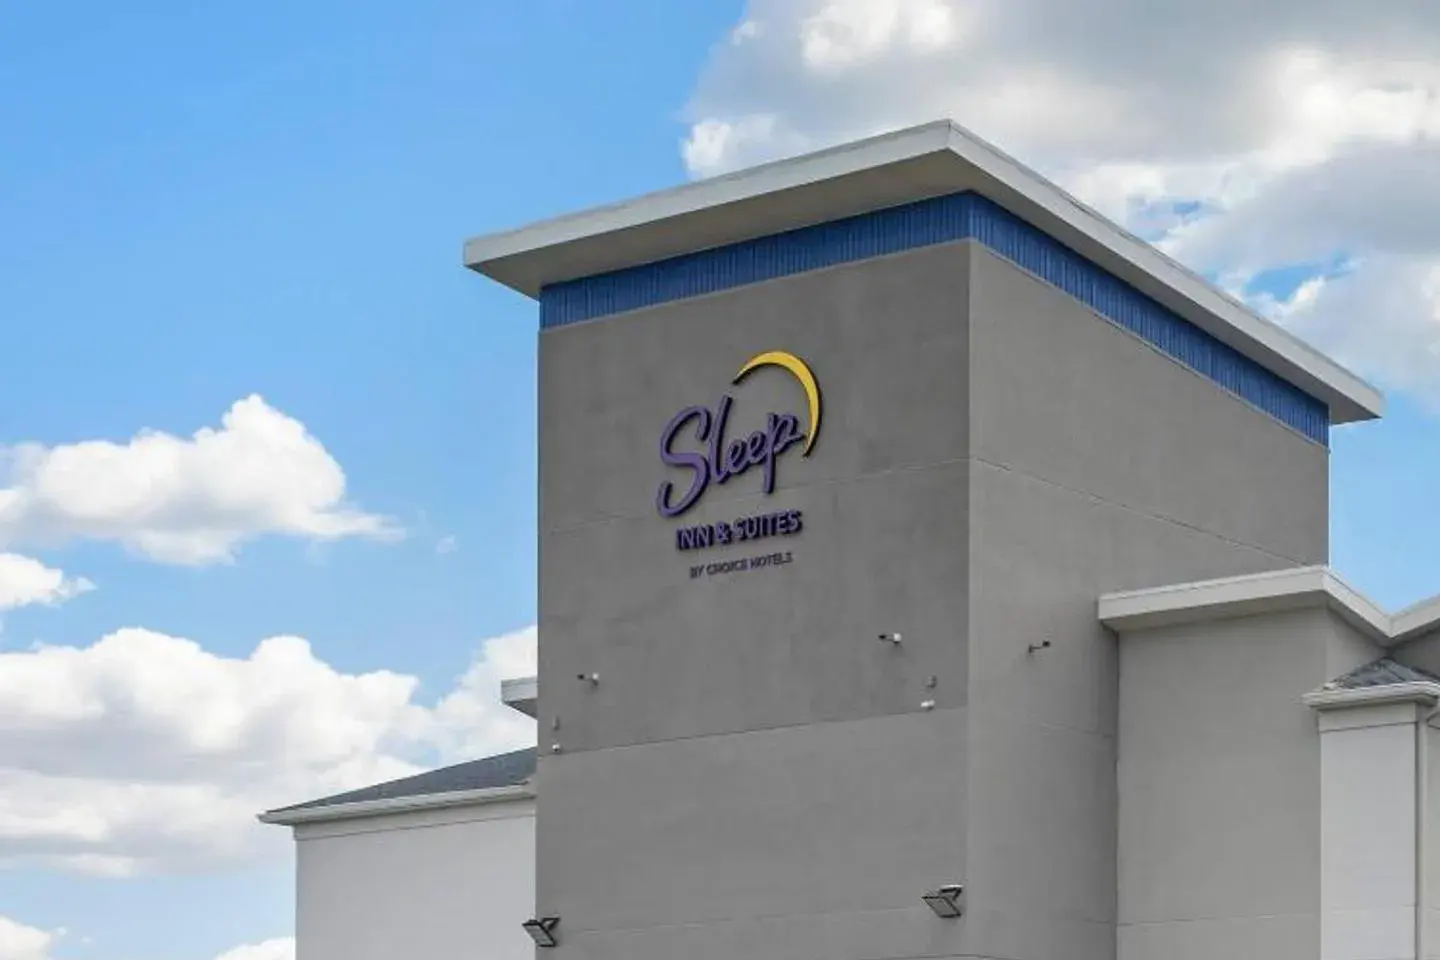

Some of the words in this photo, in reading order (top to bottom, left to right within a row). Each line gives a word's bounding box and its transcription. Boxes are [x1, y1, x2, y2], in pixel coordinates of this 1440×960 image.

[657, 395, 805, 517] Sleep
[677, 526, 714, 550] INN
[716, 521, 731, 544] &
[732, 511, 802, 541] SUITES
[690, 564, 705, 578] BY
[707, 559, 747, 576] CHOICE
[751, 552, 793, 570] HOTELS
